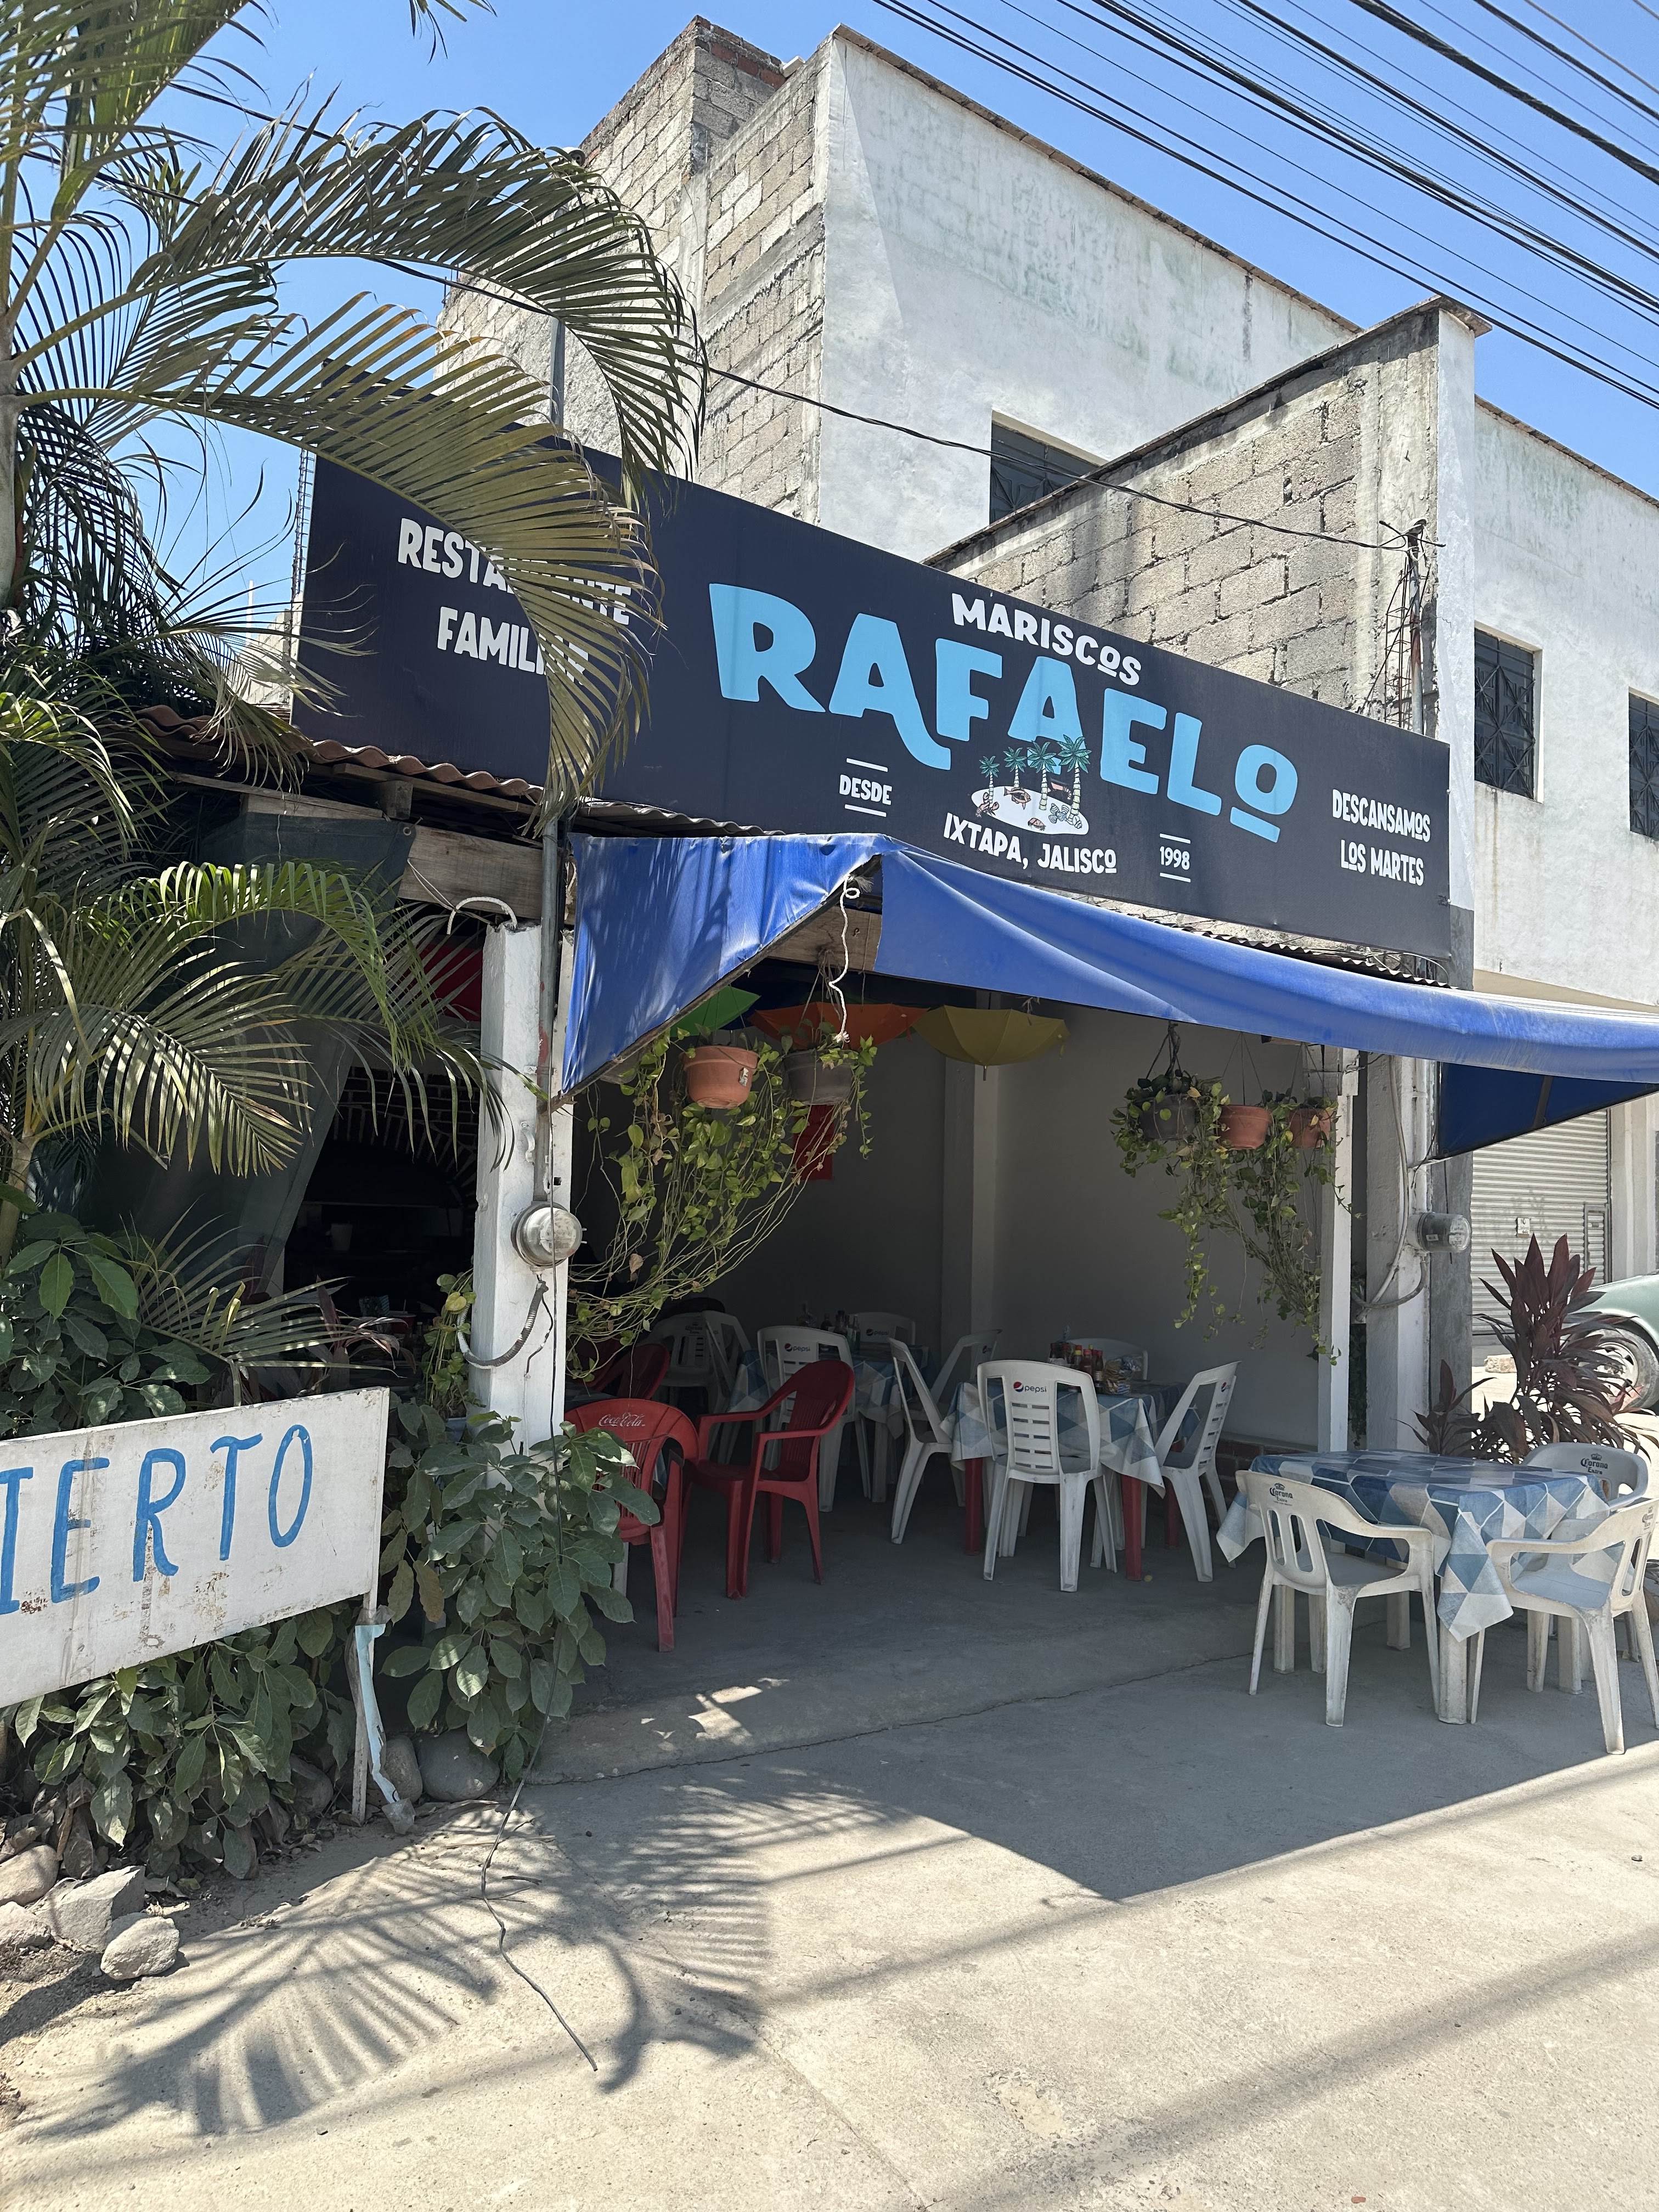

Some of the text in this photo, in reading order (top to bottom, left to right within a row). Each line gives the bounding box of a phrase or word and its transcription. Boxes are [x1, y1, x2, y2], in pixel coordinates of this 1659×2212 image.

[398, 517, 631, 625] RESTATE
[952, 593, 1142, 686] MARISCOS
[709, 583, 1297, 842] RAFAELO
[839, 774, 893, 805] DESDE
[1332, 789, 1431, 843] DESCANSAMOS
[943, 812, 1117, 874] IXTAPA, JALISCO
[1159, 846, 1191, 870] 1998
[1341, 839, 1424, 886] LOS MARTES
[1024, 1385, 1047, 1393] pepsi
[1580, 1458, 1609, 1469] Corona
[1588, 1466, 1603, 1475] Extra
[1269, 1487, 1294, 1499] Corona
